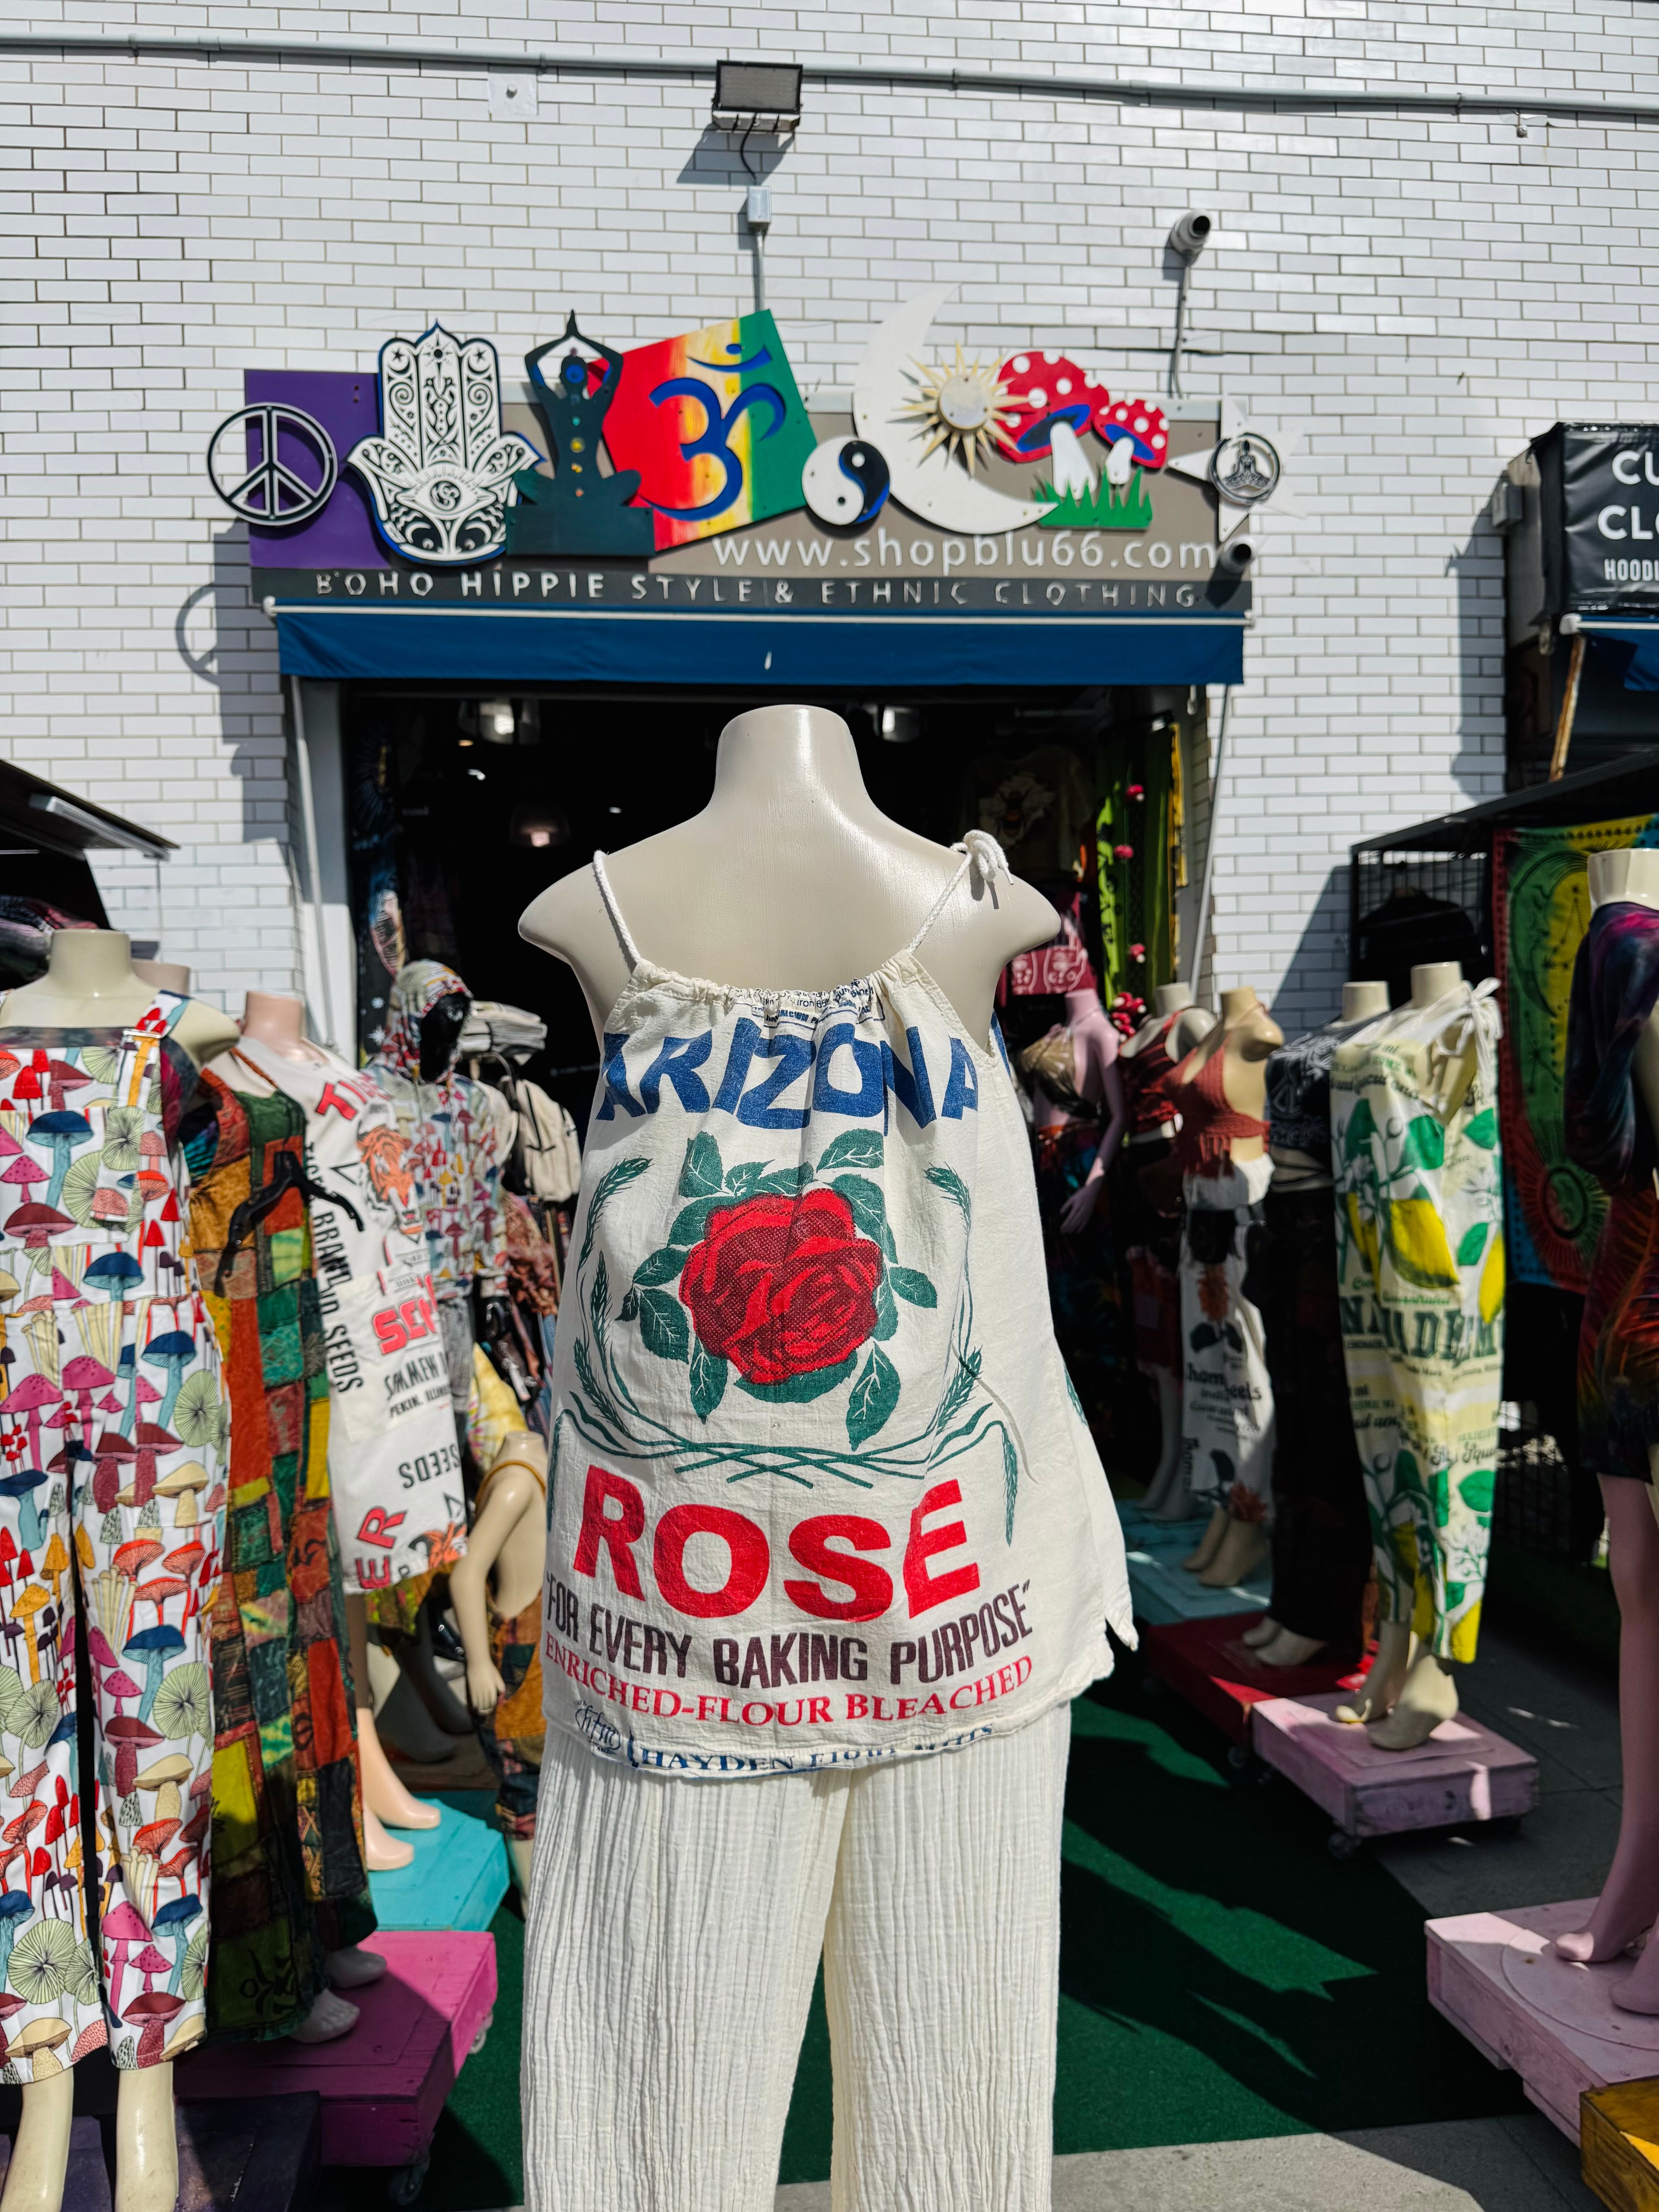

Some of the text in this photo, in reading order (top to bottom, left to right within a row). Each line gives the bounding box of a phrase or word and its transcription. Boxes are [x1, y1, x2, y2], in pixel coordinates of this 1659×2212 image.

[712, 526, 1218, 576] www.shopblu66.com
[1598, 505, 1659, 540] CL
[316, 571, 1194, 607] BOHO HIPPIE STYLE & ETHNIC CLOTHING
[596, 1017, 978, 1136] ARIZONA
[325, 1325, 364, 1393] SEEDS
[573, 1464, 981, 1623] ROSE
[546, 1630, 1032, 1726] ENRICHED-FLOUR BLEACHED
[589, 1602, 692, 1678] EVERY
[714, 1633, 867, 1689] BAKING
[640, 1747, 794, 1770] HAYDEN
